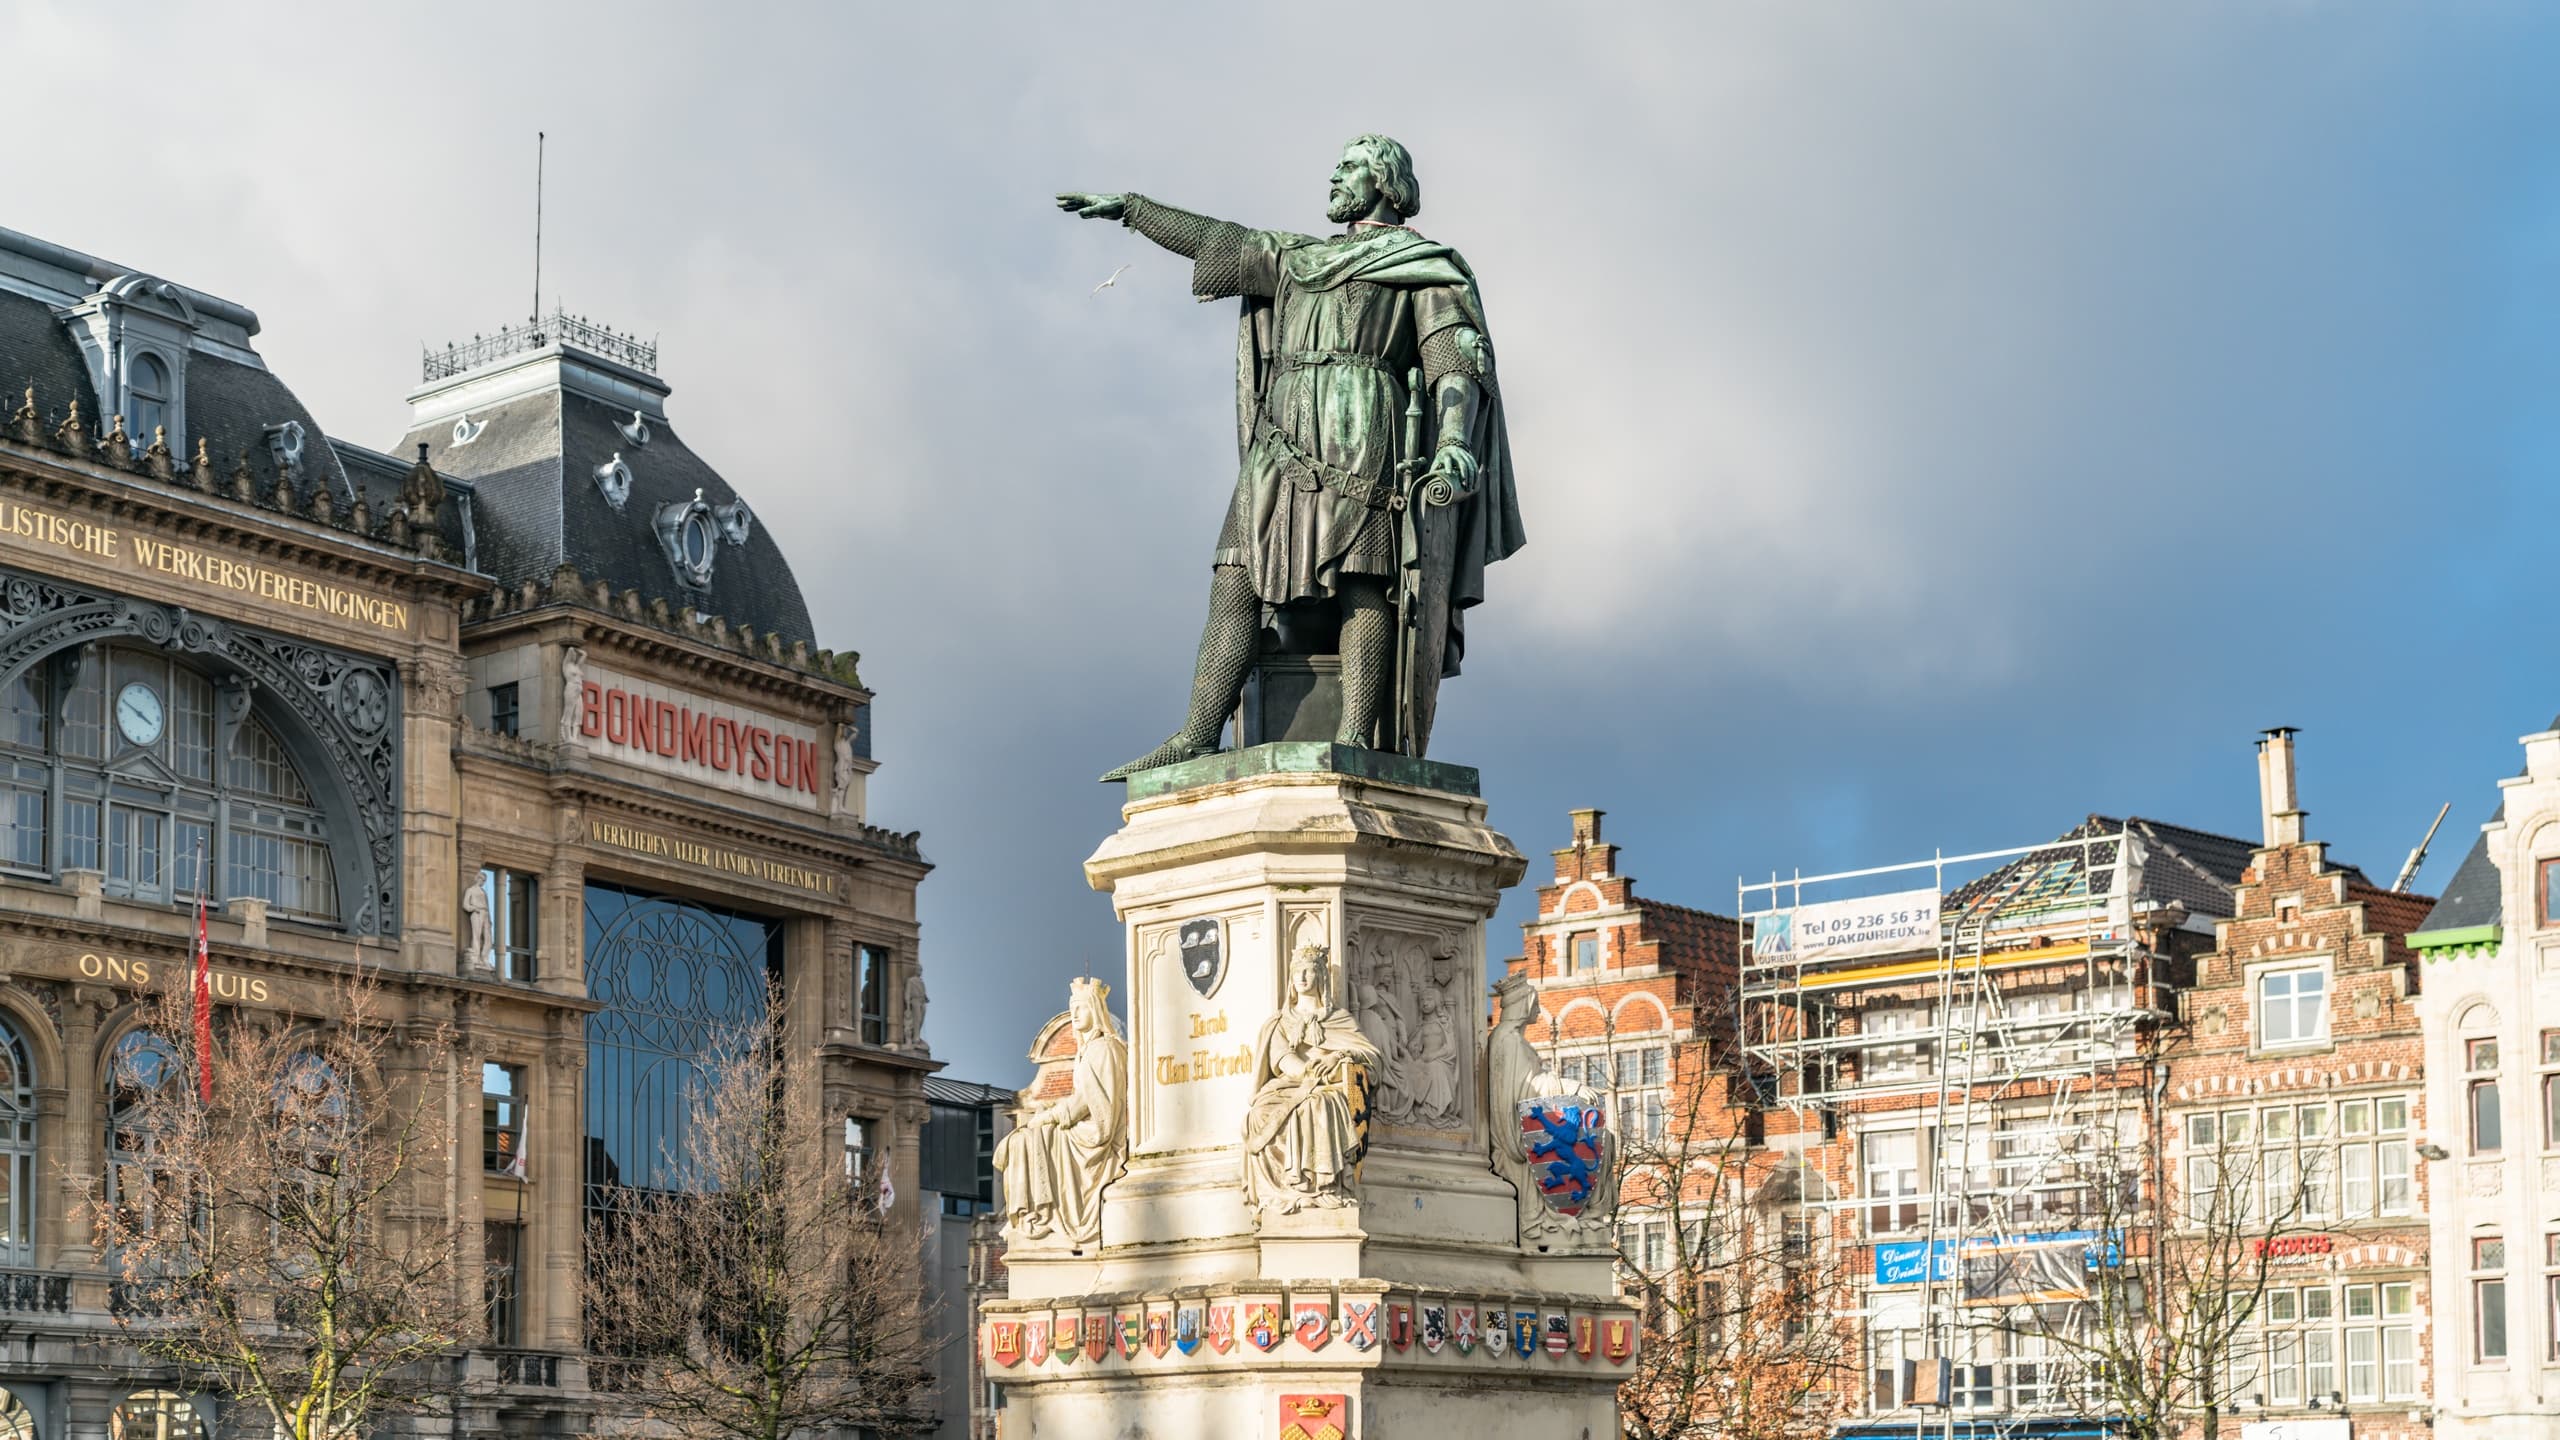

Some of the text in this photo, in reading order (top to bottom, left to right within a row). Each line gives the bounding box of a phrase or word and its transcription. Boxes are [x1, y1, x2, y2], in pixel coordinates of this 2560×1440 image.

[0, 503, 408, 631] LISTISCHE WERKERSVEREENIGINGEN
[592, 821, 669, 856] WERKLIEDEN
[674, 841, 709, 867] ALLER
[714, 849, 757, 877] LANDEN
[762, 861, 820, 892] VEREENIGT
[1802, 908, 1931, 936] Tel 09 236 56 31
[79, 953, 149, 984] ONS
[1881, 1248, 1922, 1266] Dinner
[2255, 1234, 2333, 1258] PRIMUS
[1887, 1262, 1924, 1283] Drinks
